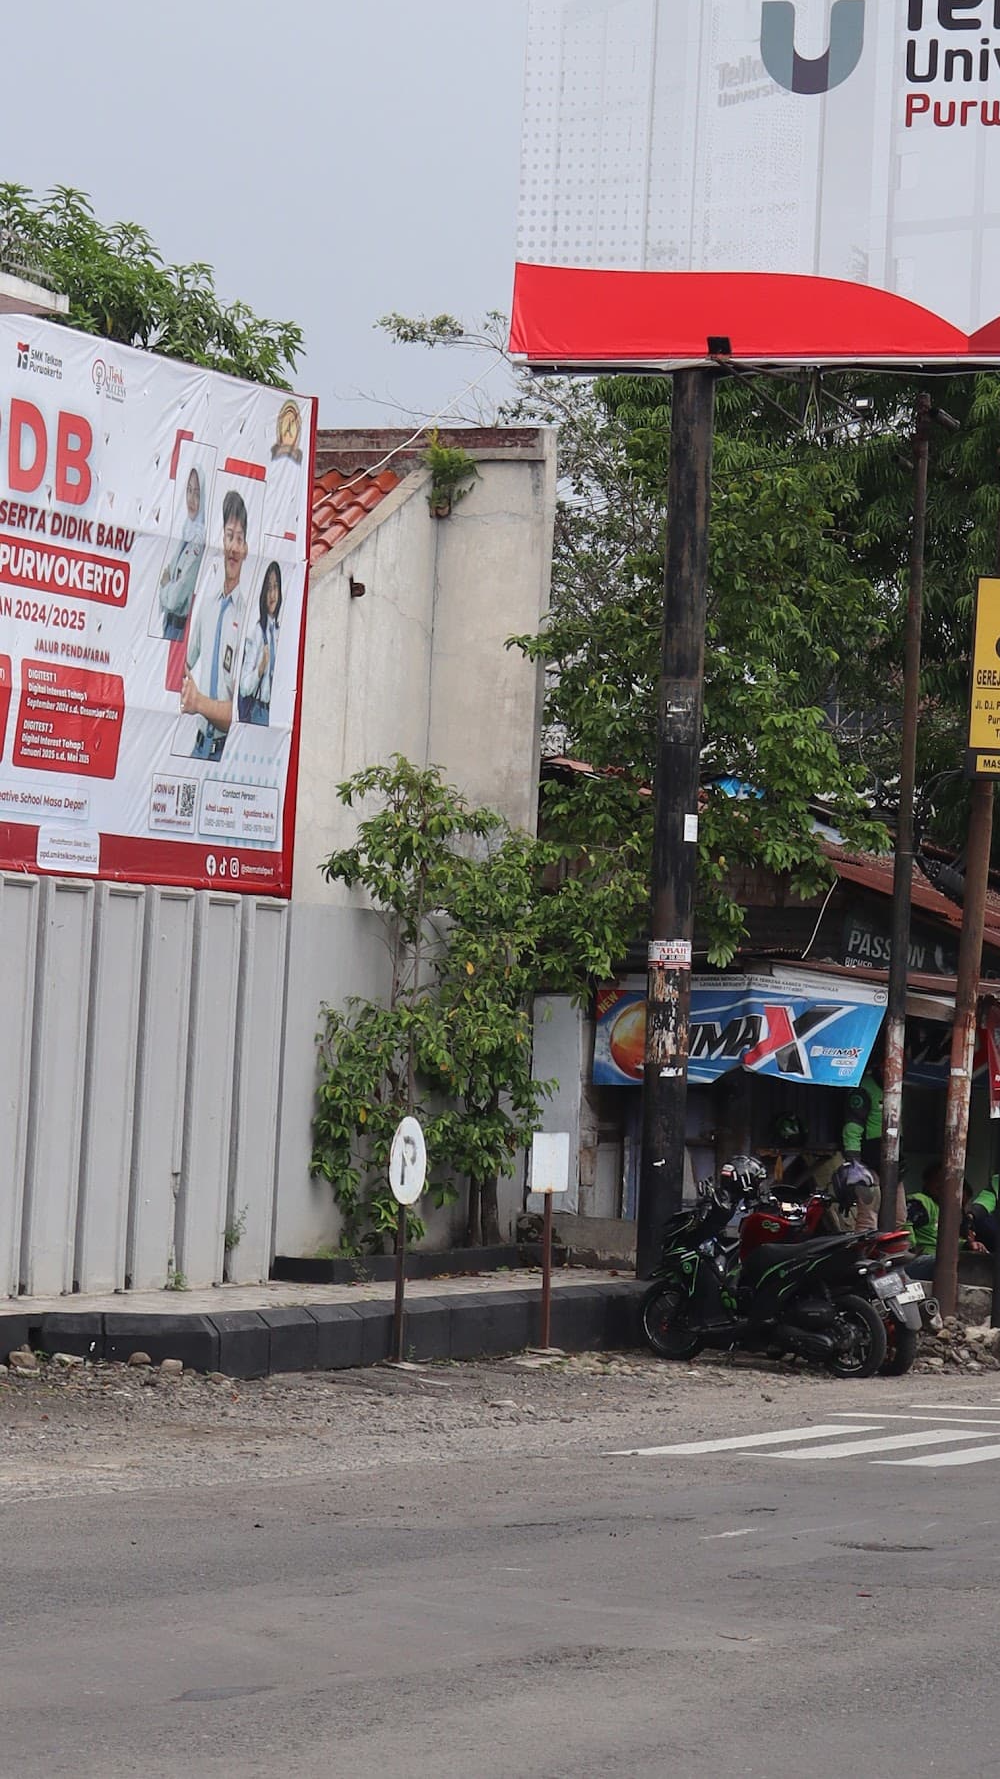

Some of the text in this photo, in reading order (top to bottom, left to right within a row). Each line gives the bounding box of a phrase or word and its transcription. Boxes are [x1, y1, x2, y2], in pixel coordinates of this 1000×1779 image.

[30, 349, 63, 368] SMK Telkom
[29, 361, 63, 380] Purwokerto
[0, 397, 93, 506] DB
[50, 512, 94, 544] DIDIK
[96, 523, 136, 553] BARU
[0, 543, 125, 598] PURWOKERTO
[15, 599, 86, 631] 2024/2025
[34, 638, 59, 655] JALUR
[28, 668, 53, 682] DIGITEST
[28, 682, 46, 695] Digital
[47, 686, 67, 698] Interest
[27, 697, 55, 710] September
[56, 701, 69, 712] 2024
[975, 700, 983, 710] Jl.
[23, 719, 53, 733] DIGITEST 2
[22, 733, 39, 745] Digital
[40, 735, 61, 748] Interest
[20, 747, 41, 758] Januari
[67, 752, 78, 762] Mei
[20, 792, 43, 806] School
[43, 795, 62, 808] Masa
[222, 789, 256, 801] Contact Person
[152, 802, 167, 813] NOW
[848, 930, 925, 968] PASSN
[600, 991, 619, 1014] NEW
